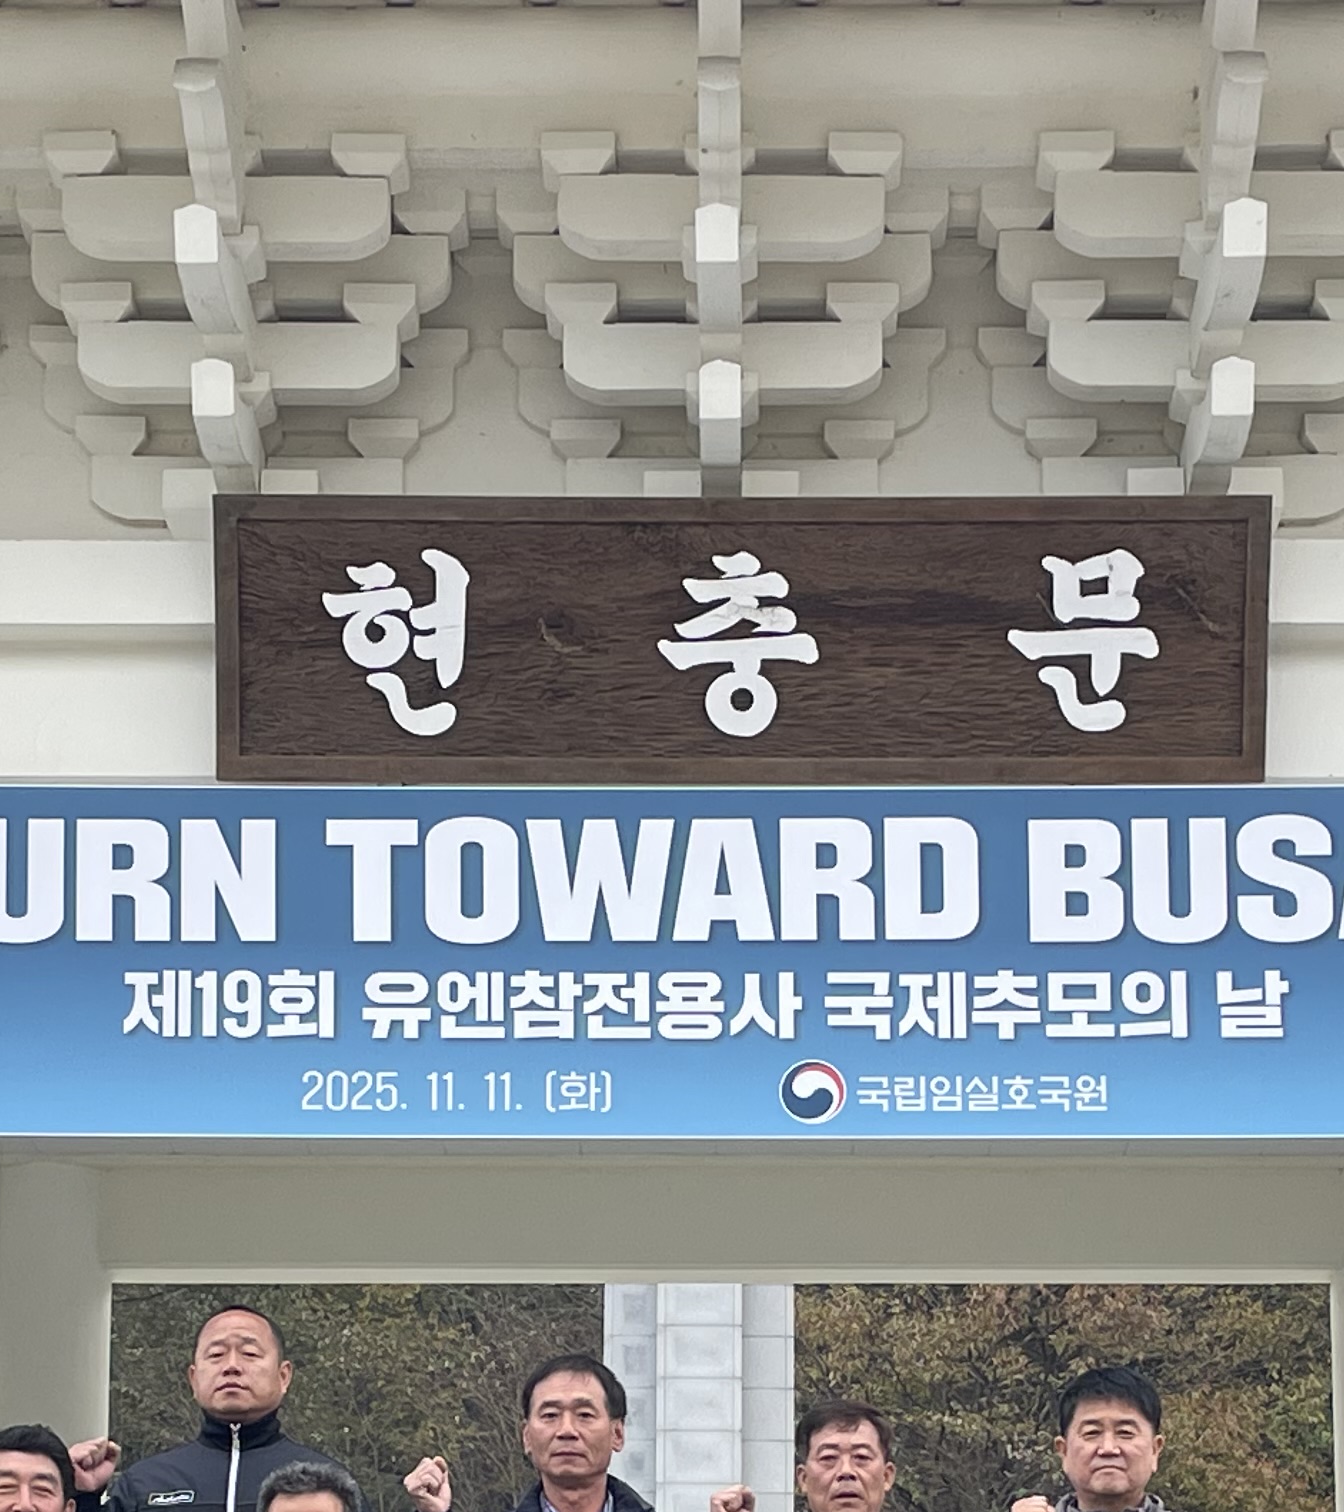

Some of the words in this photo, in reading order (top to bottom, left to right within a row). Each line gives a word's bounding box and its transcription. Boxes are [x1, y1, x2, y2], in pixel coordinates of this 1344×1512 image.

[322, 549, 1160, 737] 현충문
[325, 816, 981, 945] TOWARD
[122, 969, 336, 1039] 제19회
[362, 970, 803, 1040] 유엔참전용사
[824, 970, 1189, 1040] 국제추모의
[1216, 969, 1291, 1039] 날
[301, 1070, 408, 1112] 2025.
[426, 1072, 465, 1111] 11.
[484, 1072, 523, 1111] 11.
[545, 1070, 612, 1113] (화)
[857, 1075, 1108, 1113] 국립임실호국원
